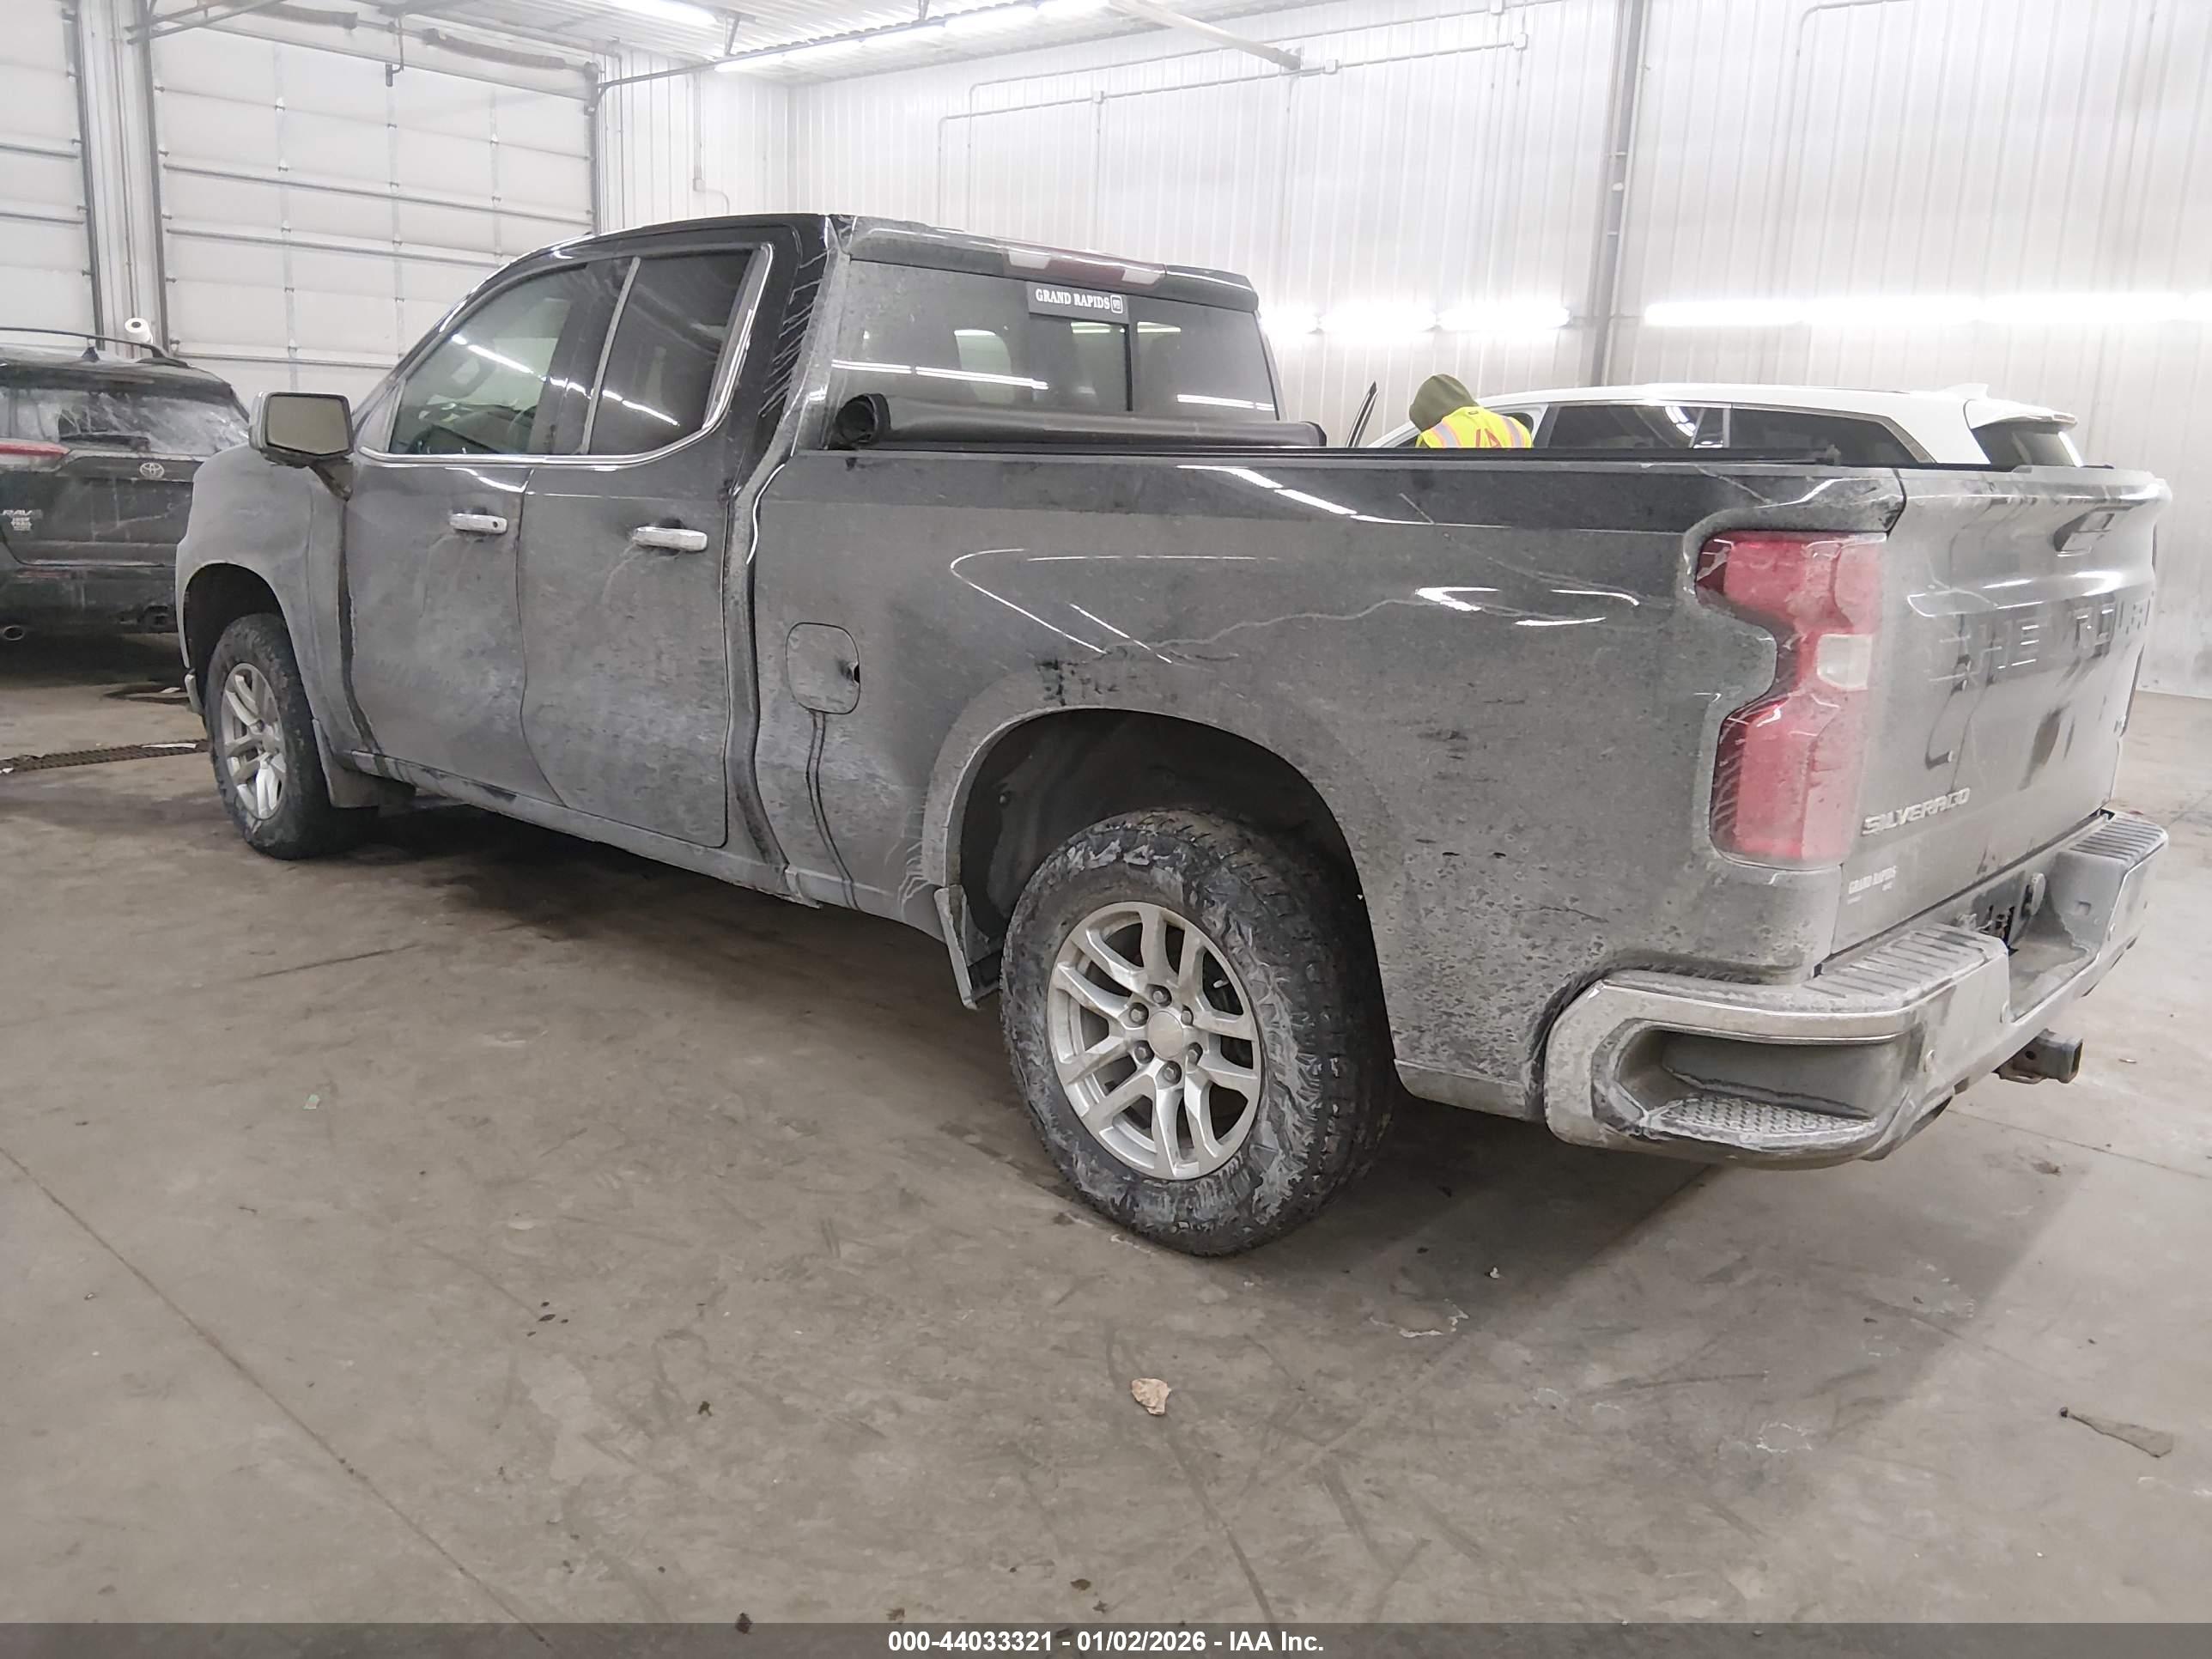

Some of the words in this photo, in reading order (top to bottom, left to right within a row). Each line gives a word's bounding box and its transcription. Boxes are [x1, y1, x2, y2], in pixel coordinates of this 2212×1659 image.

[1036, 289, 1072, 305] GRAND
[1073, 293, 1110, 309] RAPIDS
[1861, 787, 1971, 836] SILVERADO
